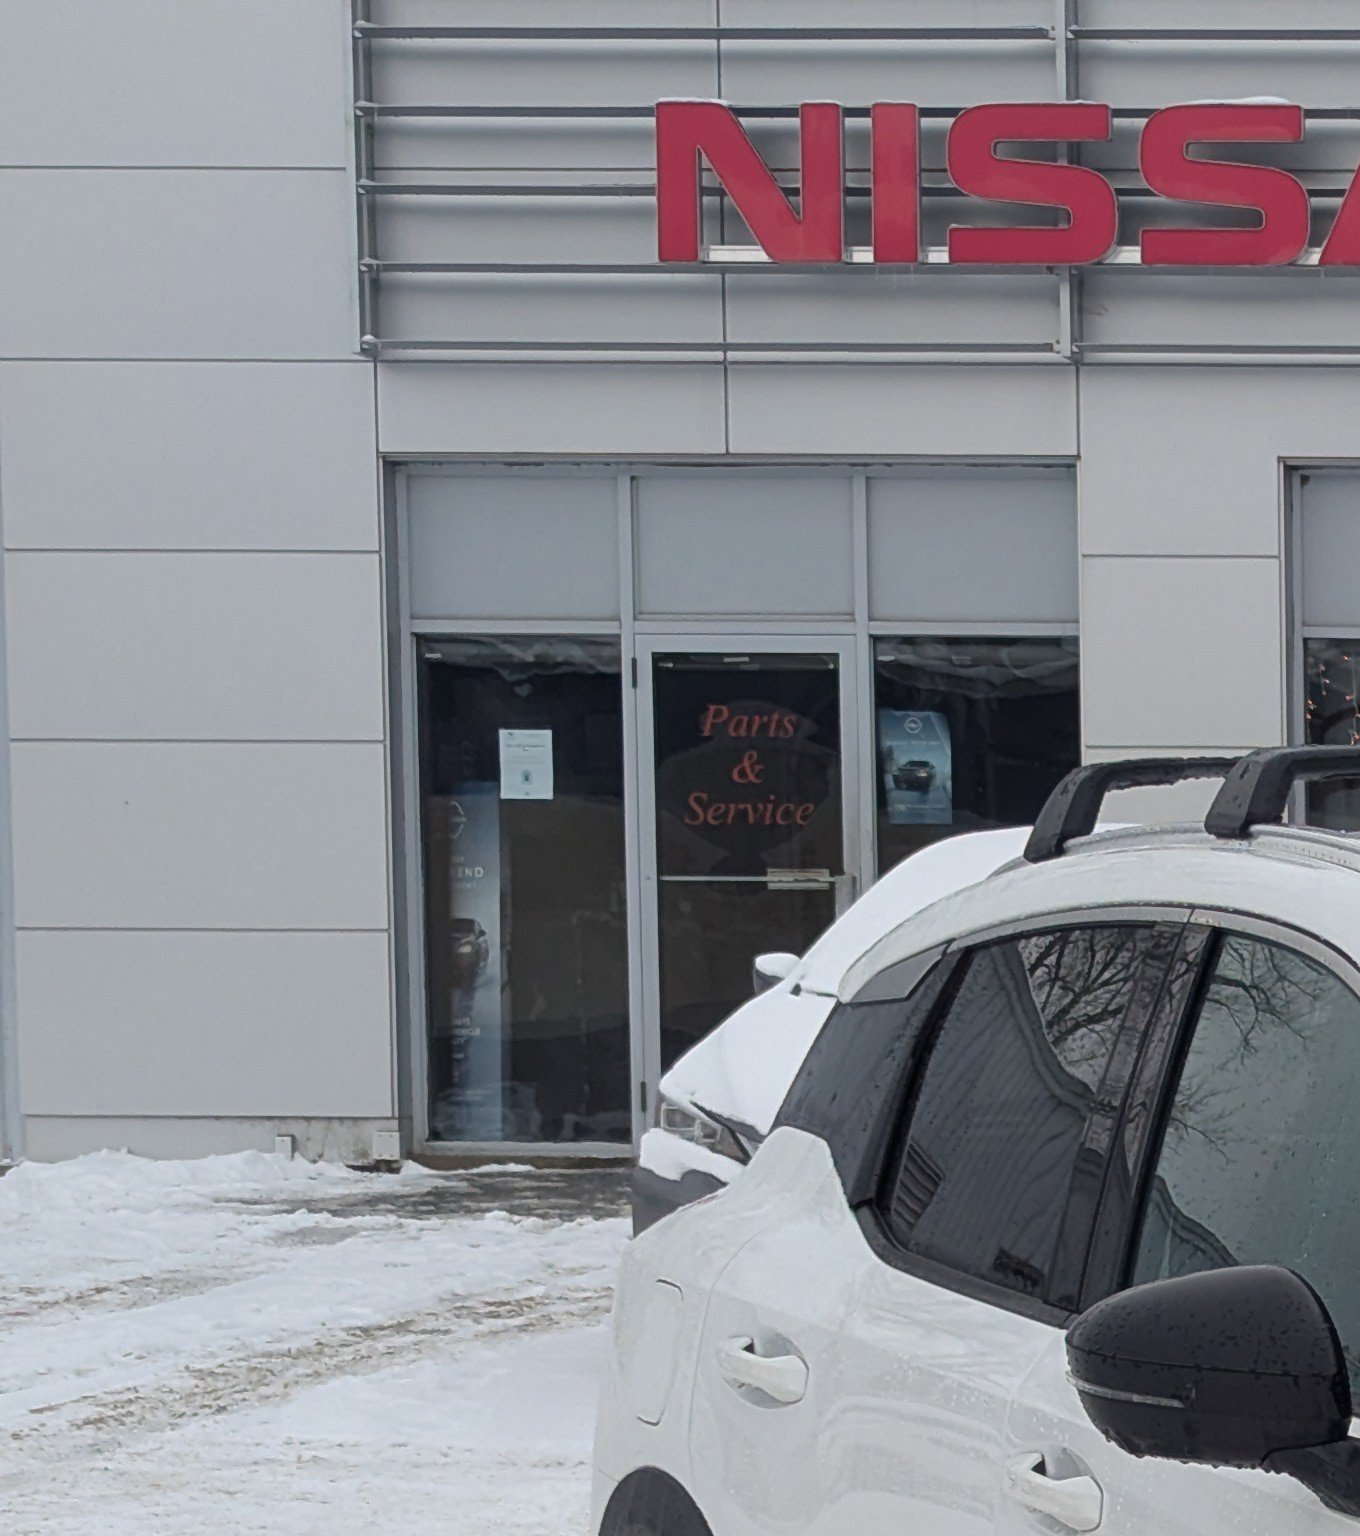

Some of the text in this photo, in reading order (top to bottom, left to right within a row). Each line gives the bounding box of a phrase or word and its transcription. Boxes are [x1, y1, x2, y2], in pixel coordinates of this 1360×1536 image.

[701, 703, 798, 738] Parts
[731, 750, 765, 784] &
[684, 792, 815, 826] Service
